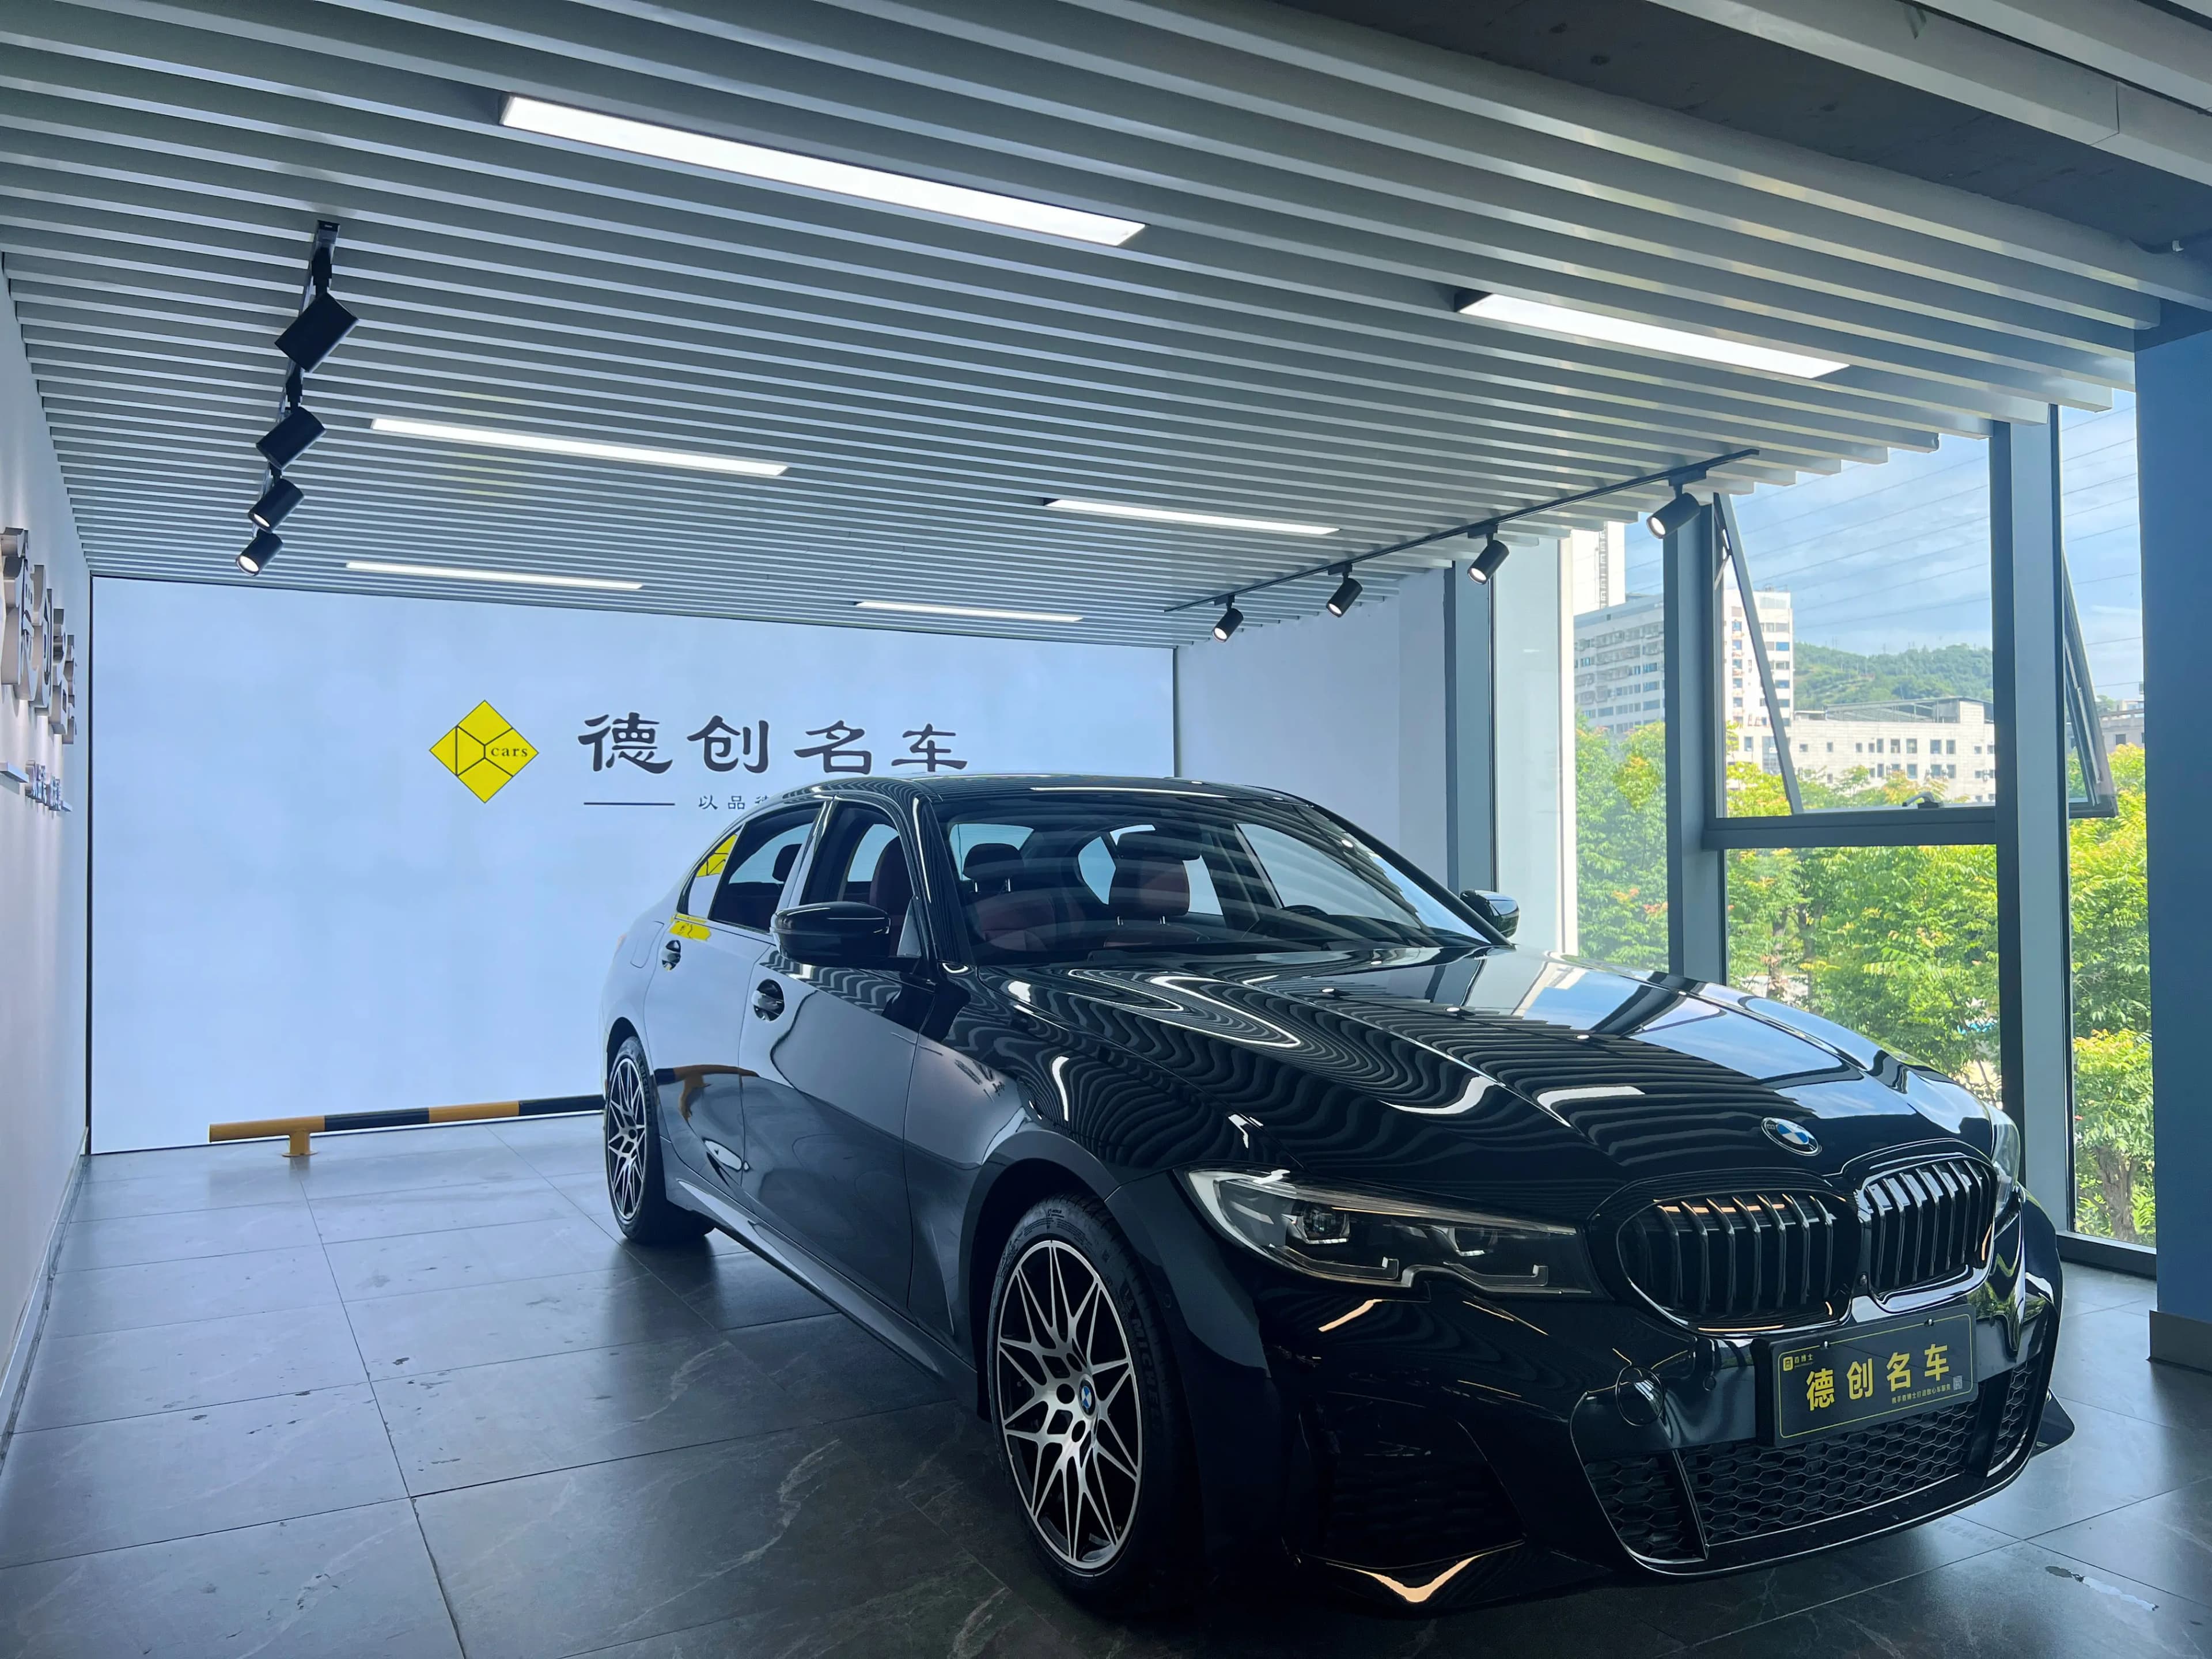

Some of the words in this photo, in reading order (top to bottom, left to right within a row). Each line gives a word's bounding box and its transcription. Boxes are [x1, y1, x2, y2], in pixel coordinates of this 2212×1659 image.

[490, 747, 528, 757] cars
[578, 712, 968, 775] 德创名车
[1806, 1343, 1950, 1411] 德创名车
